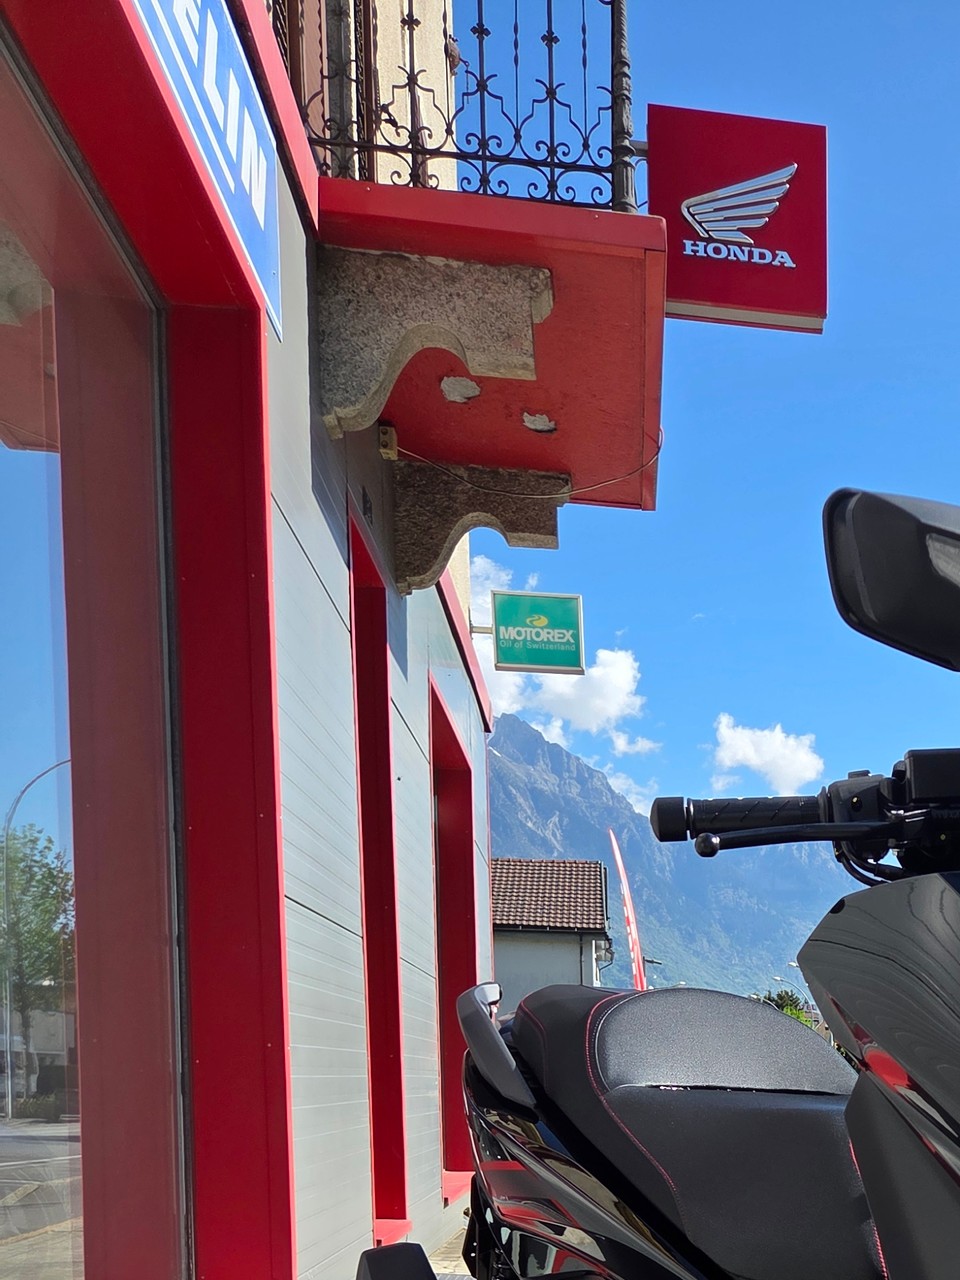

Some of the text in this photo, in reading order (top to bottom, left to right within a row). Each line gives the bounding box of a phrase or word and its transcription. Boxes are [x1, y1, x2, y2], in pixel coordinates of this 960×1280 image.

[683, 239, 797, 269] HONDA
[499, 625, 576, 644] MOTOREX
[499, 640, 576, 651] Oil of Switzerland
